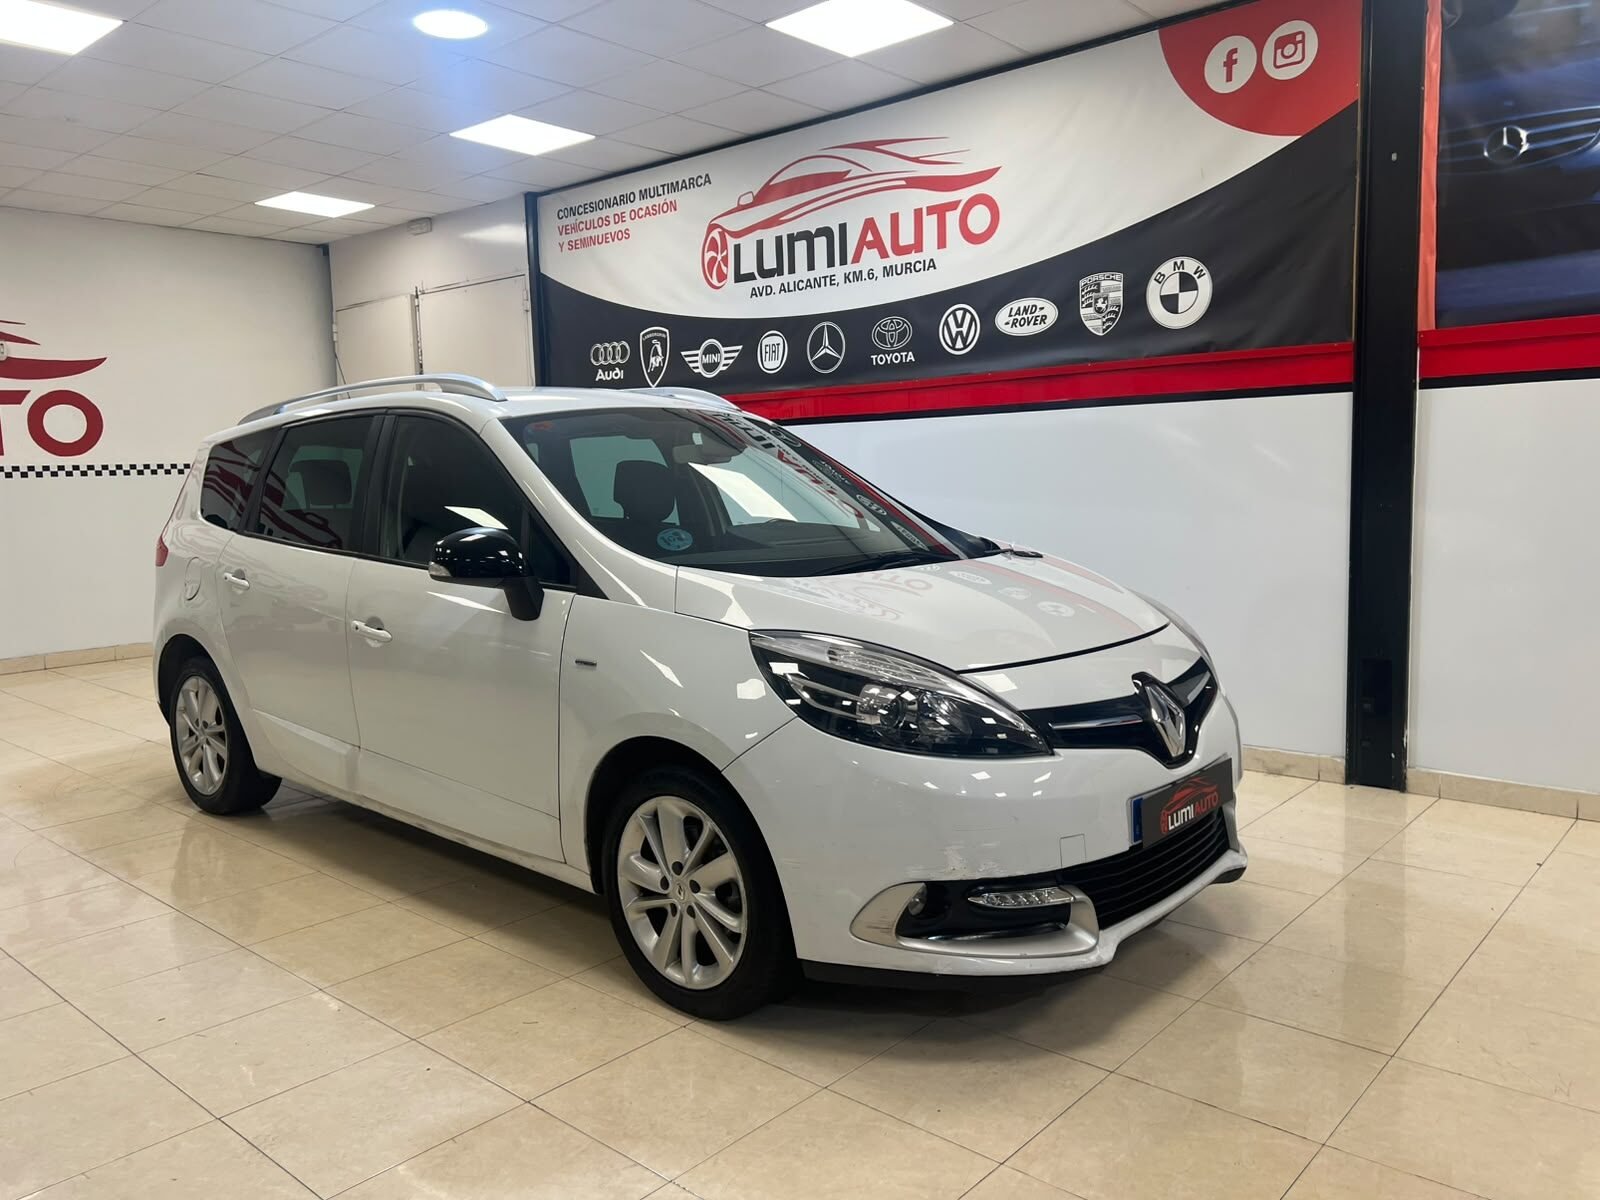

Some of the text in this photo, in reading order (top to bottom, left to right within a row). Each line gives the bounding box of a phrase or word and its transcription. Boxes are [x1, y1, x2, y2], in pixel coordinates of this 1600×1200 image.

[557, 173, 712, 220] CONCESIONARIO MULTIMARCA
[558, 198, 678, 236] VEHÍCULOS DE OCASIÓN
[558, 228, 631, 253] Y SEMINUEVOS
[750, 258, 937, 299] AVD. ALICANTE, KM.6, MURCIA
[1081, 273, 1122, 285] PORSCHE
[1153, 260, 1206, 285] BMW
[702, 352, 721, 364] MINI
[764, 343, 781, 362] FIAT
[870, 351, 915, 366] TOYOTA
[595, 368, 624, 381] Audi
